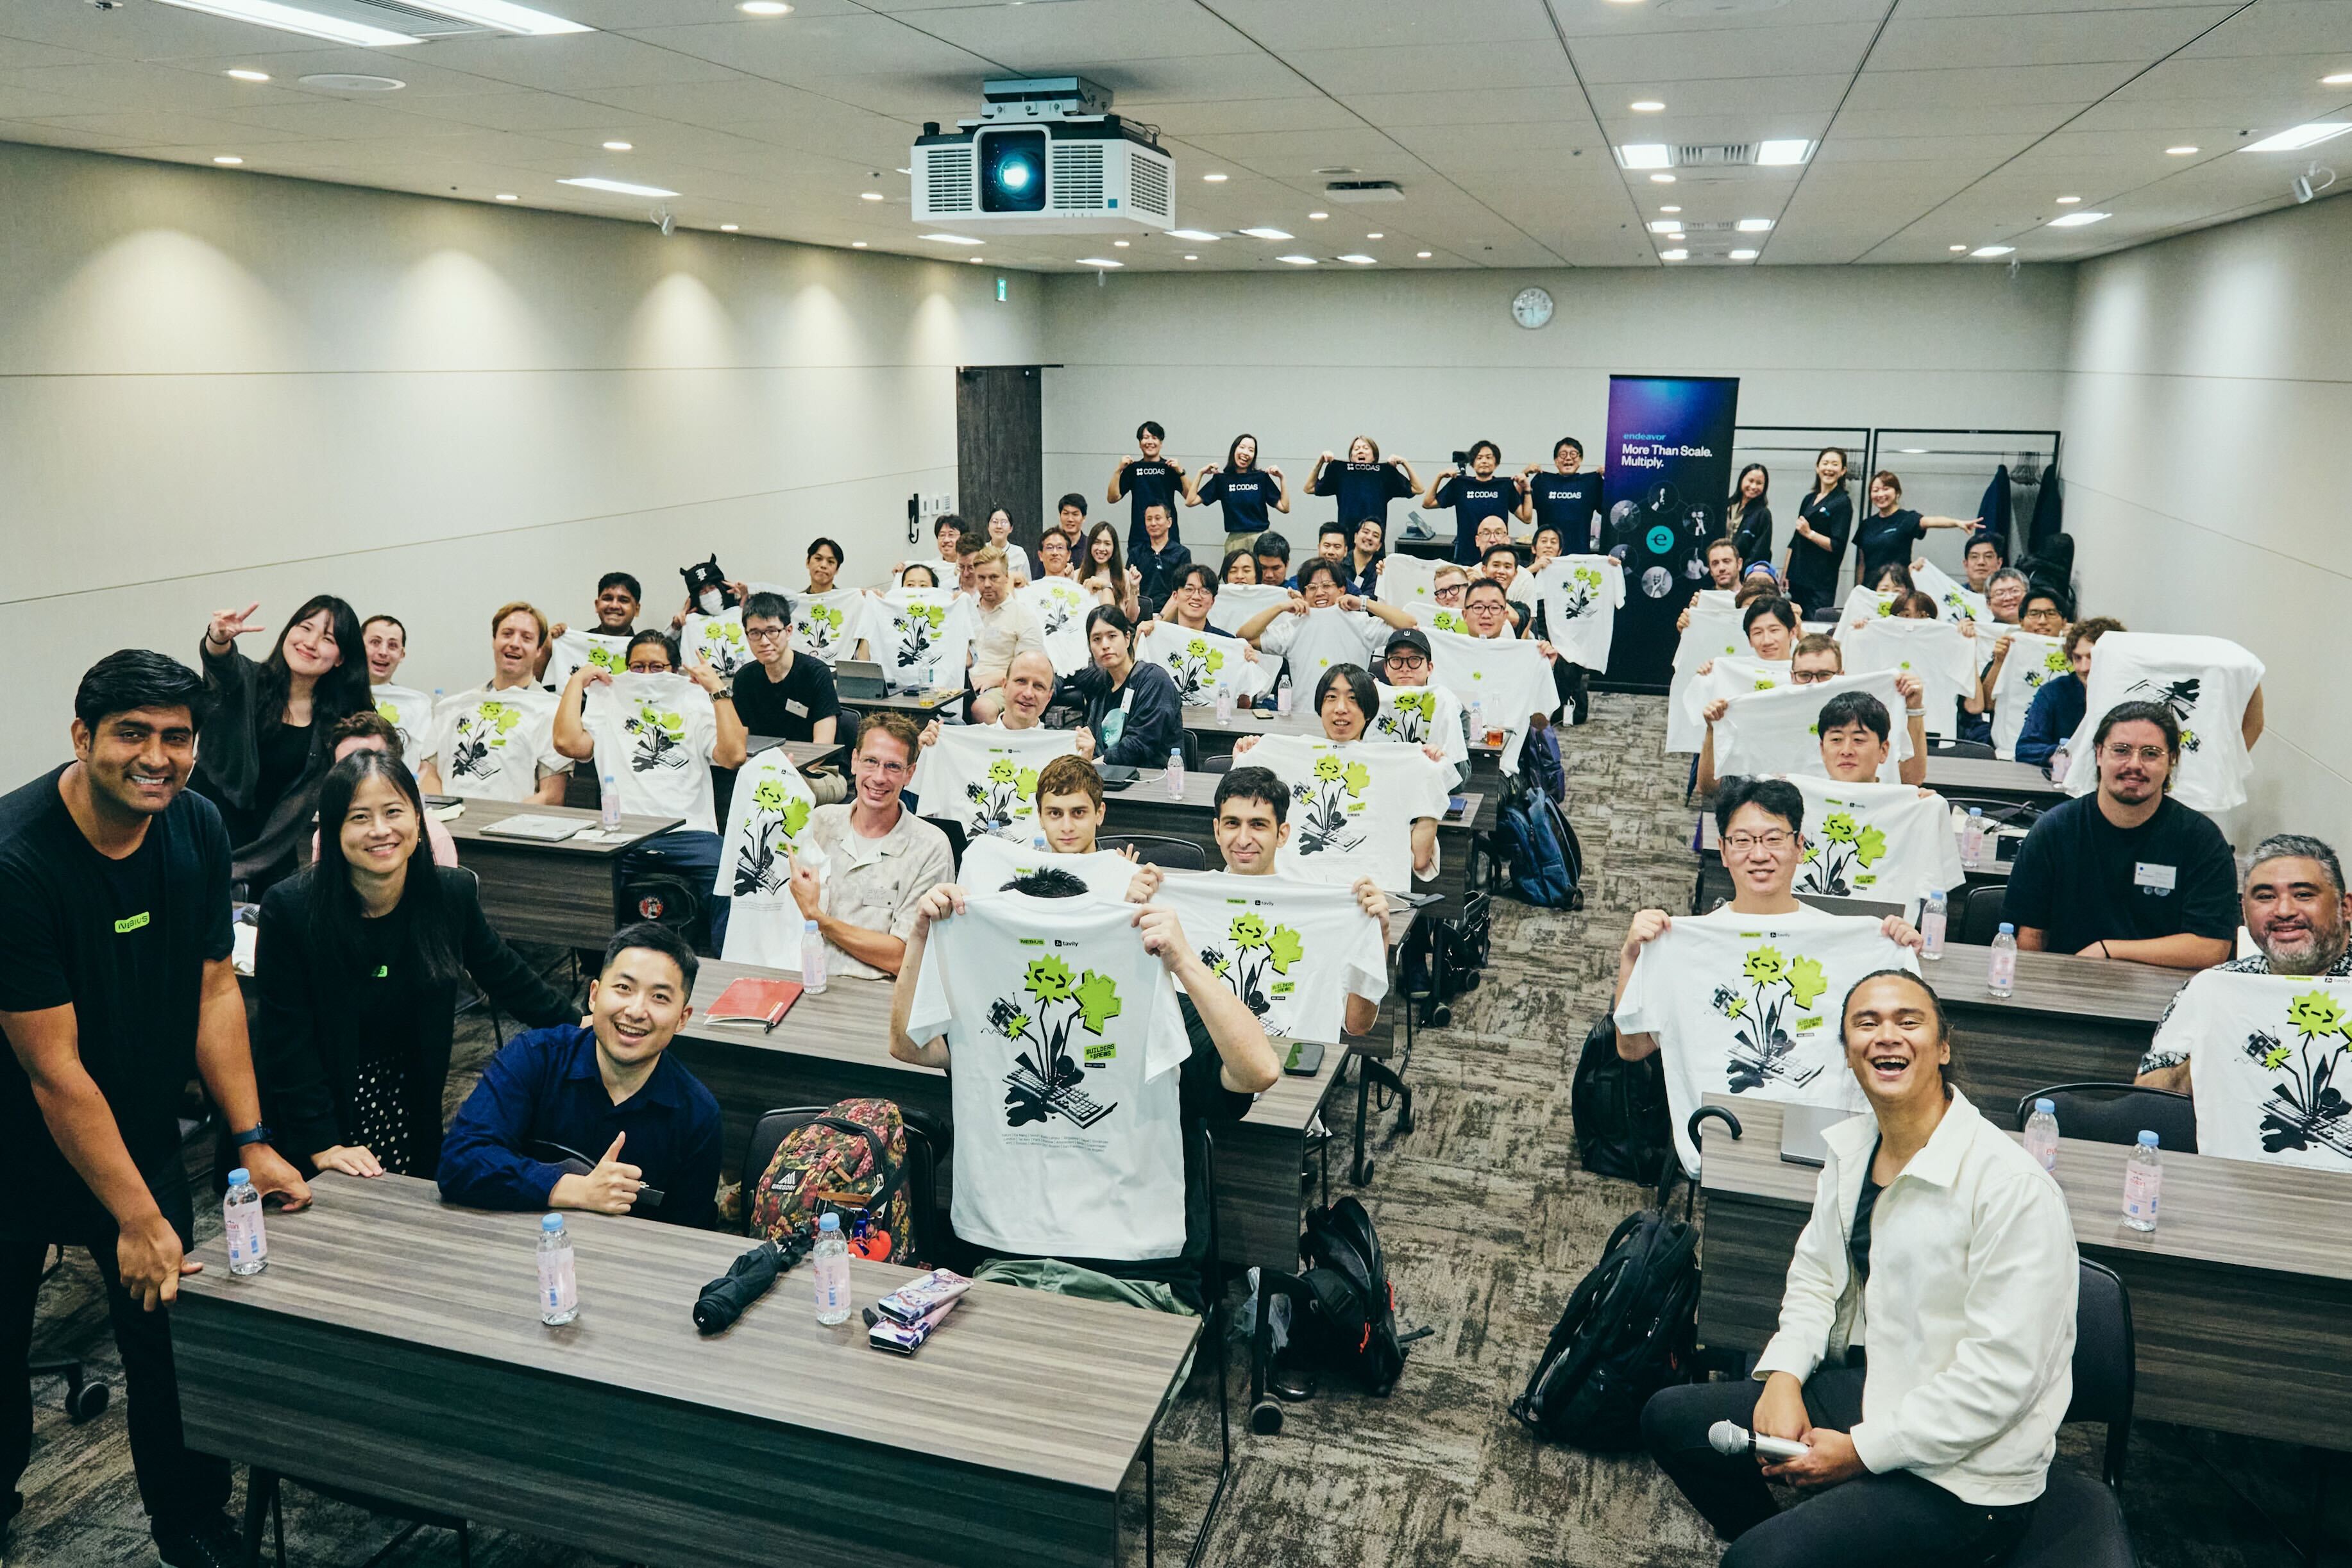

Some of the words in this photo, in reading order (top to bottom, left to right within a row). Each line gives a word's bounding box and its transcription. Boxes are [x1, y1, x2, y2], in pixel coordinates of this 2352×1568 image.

[1623, 432, 1666, 441] endeavor
[1622, 444, 1649, 455] More
[1652, 444, 1679, 456] Than
[1680, 445, 1713, 457] Scale.
[1621, 455, 1664, 469] Multiply.
[118, 916, 148, 929] NEBIUS
[1086, 1043, 1114, 1055] BUILDERS
